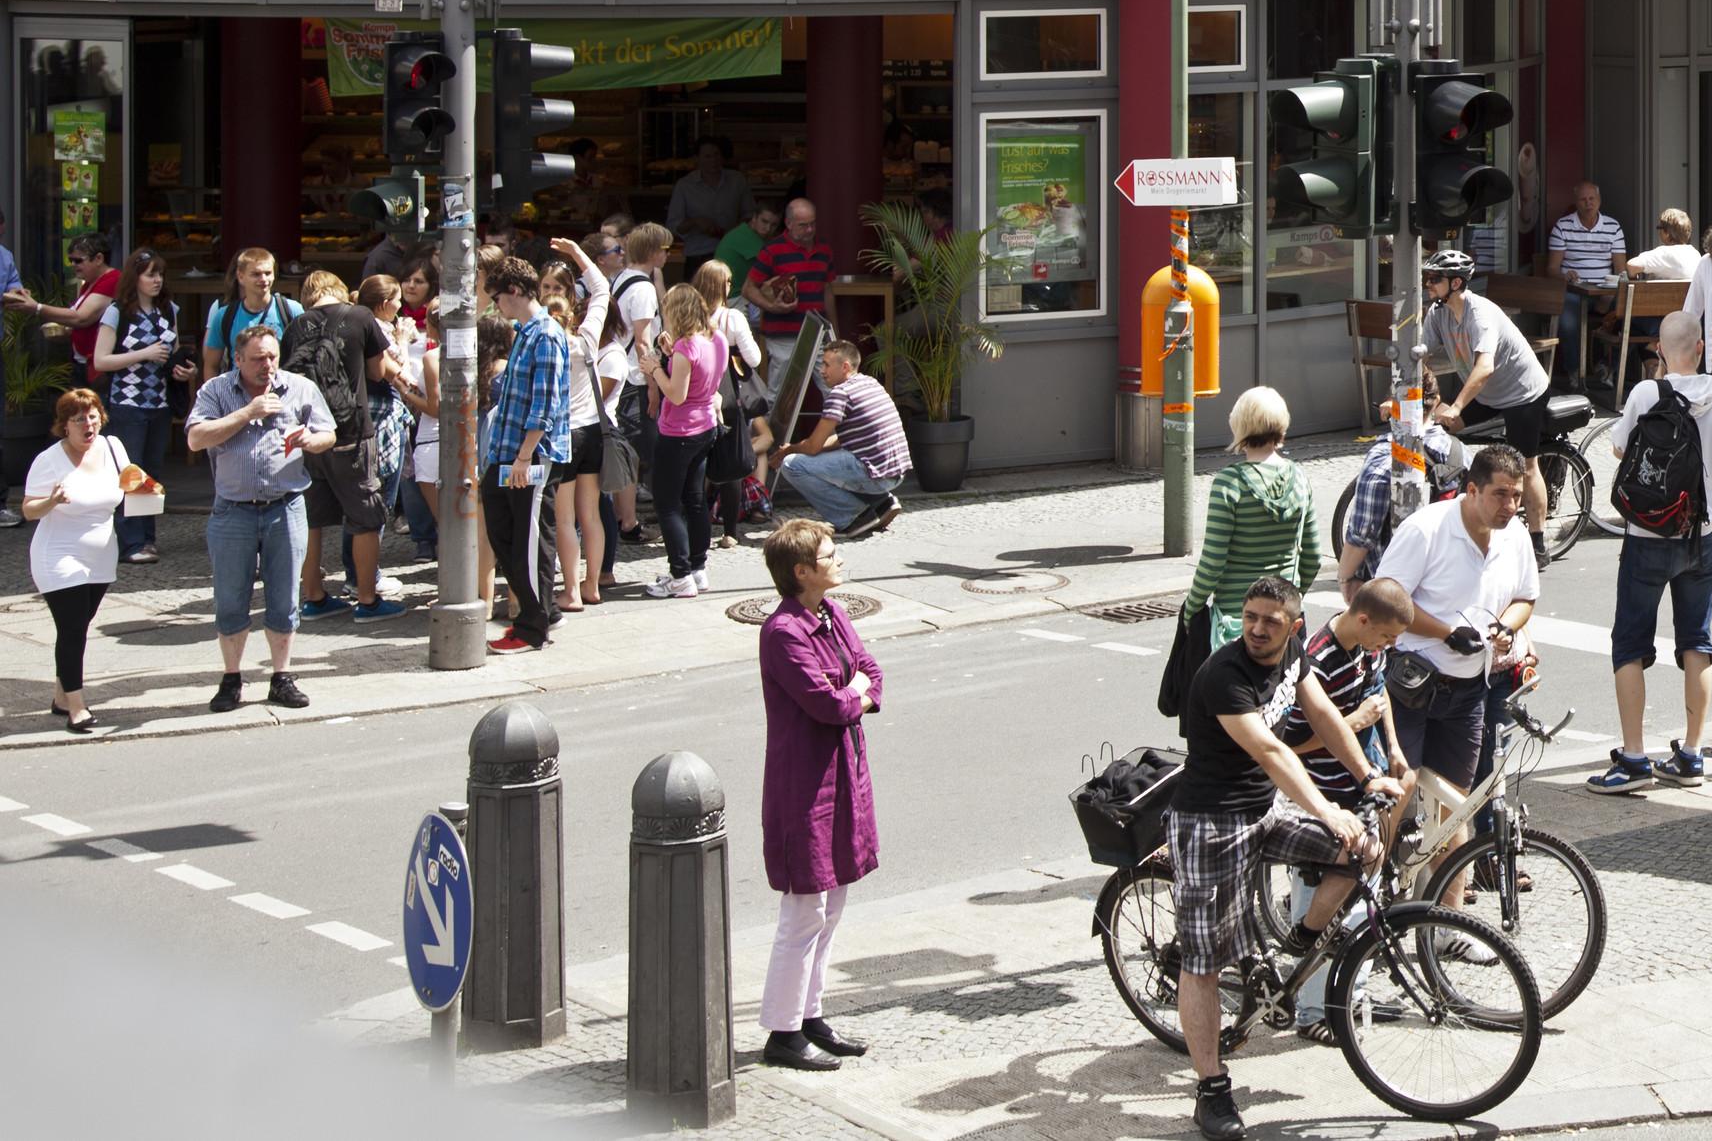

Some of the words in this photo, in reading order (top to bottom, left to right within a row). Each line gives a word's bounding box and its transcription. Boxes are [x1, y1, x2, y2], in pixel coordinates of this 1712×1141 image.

[332, 27, 391, 44] Somm
[615, 37, 653, 64] der
[664, 20, 772, 60] Sommer!
[346, 44, 385, 58] Fris
[1001, 158, 1049, 173] Frisches?
[1136, 170, 1221, 187] ROSSMANN
[1166, 187, 1207, 196] Drogeriemarkt
[440, 850, 458, 877] radio
[1314, 905, 1345, 950] GIANT
